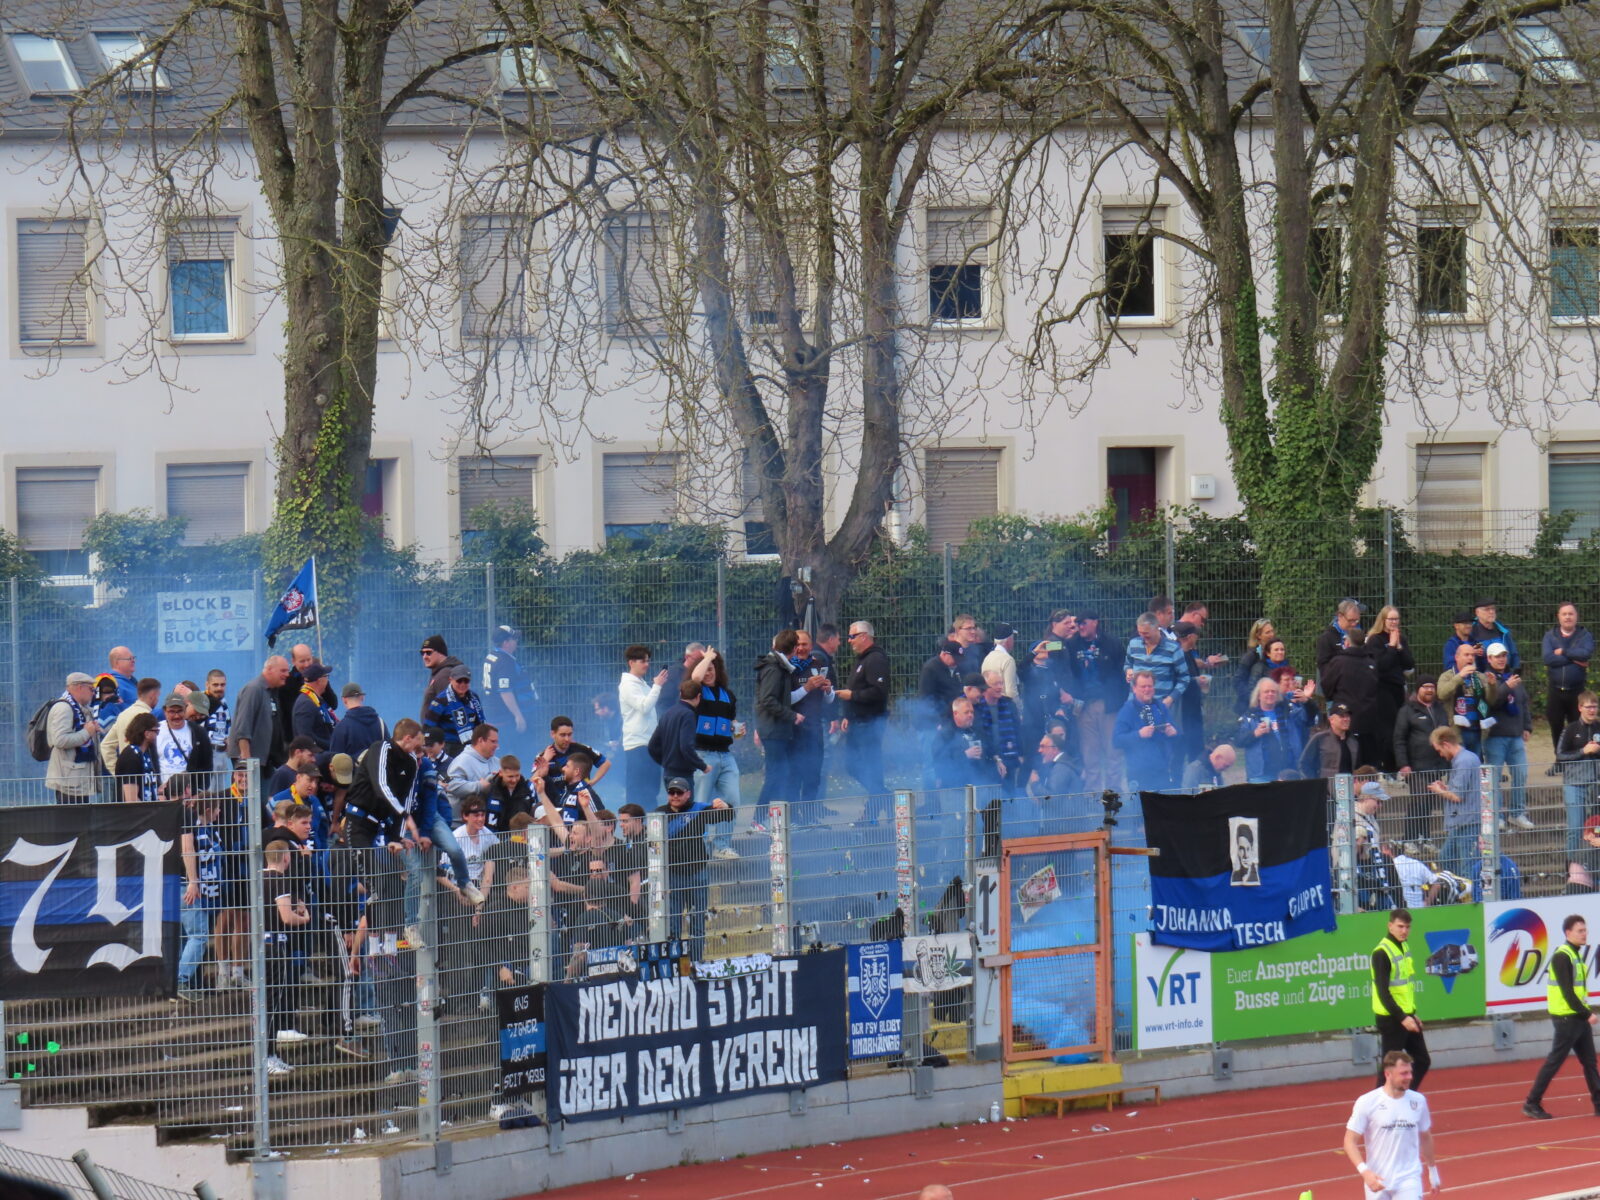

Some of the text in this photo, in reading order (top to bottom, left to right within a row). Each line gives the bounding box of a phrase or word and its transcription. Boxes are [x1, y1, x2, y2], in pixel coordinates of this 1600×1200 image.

[162, 596, 232, 611] BLOCK B
[164, 628, 233, 644] BLOCK C
[1156, 904, 1233, 932] JOHANNA
[1234, 921, 1286, 946] TESCH
[1226, 952, 1371, 985] Euer Ansprechpartn
[1146, 957, 1201, 1007] VRT
[577, 960, 799, 1044] NIEMAND STEHT
[1234, 980, 1372, 1011] Busse und Züge in d
[852, 1018, 901, 1035] DER FSV BLEIBT
[1145, 1017, 1204, 1033] www.vrt-info.de
[511, 1044, 537, 1062] KRAFT
[852, 1033, 900, 1056] UNABHÄNGIG
[503, 1071, 523, 1089] SEIT
[559, 1026, 819, 1115] ÜBER DEM VEREIN!
